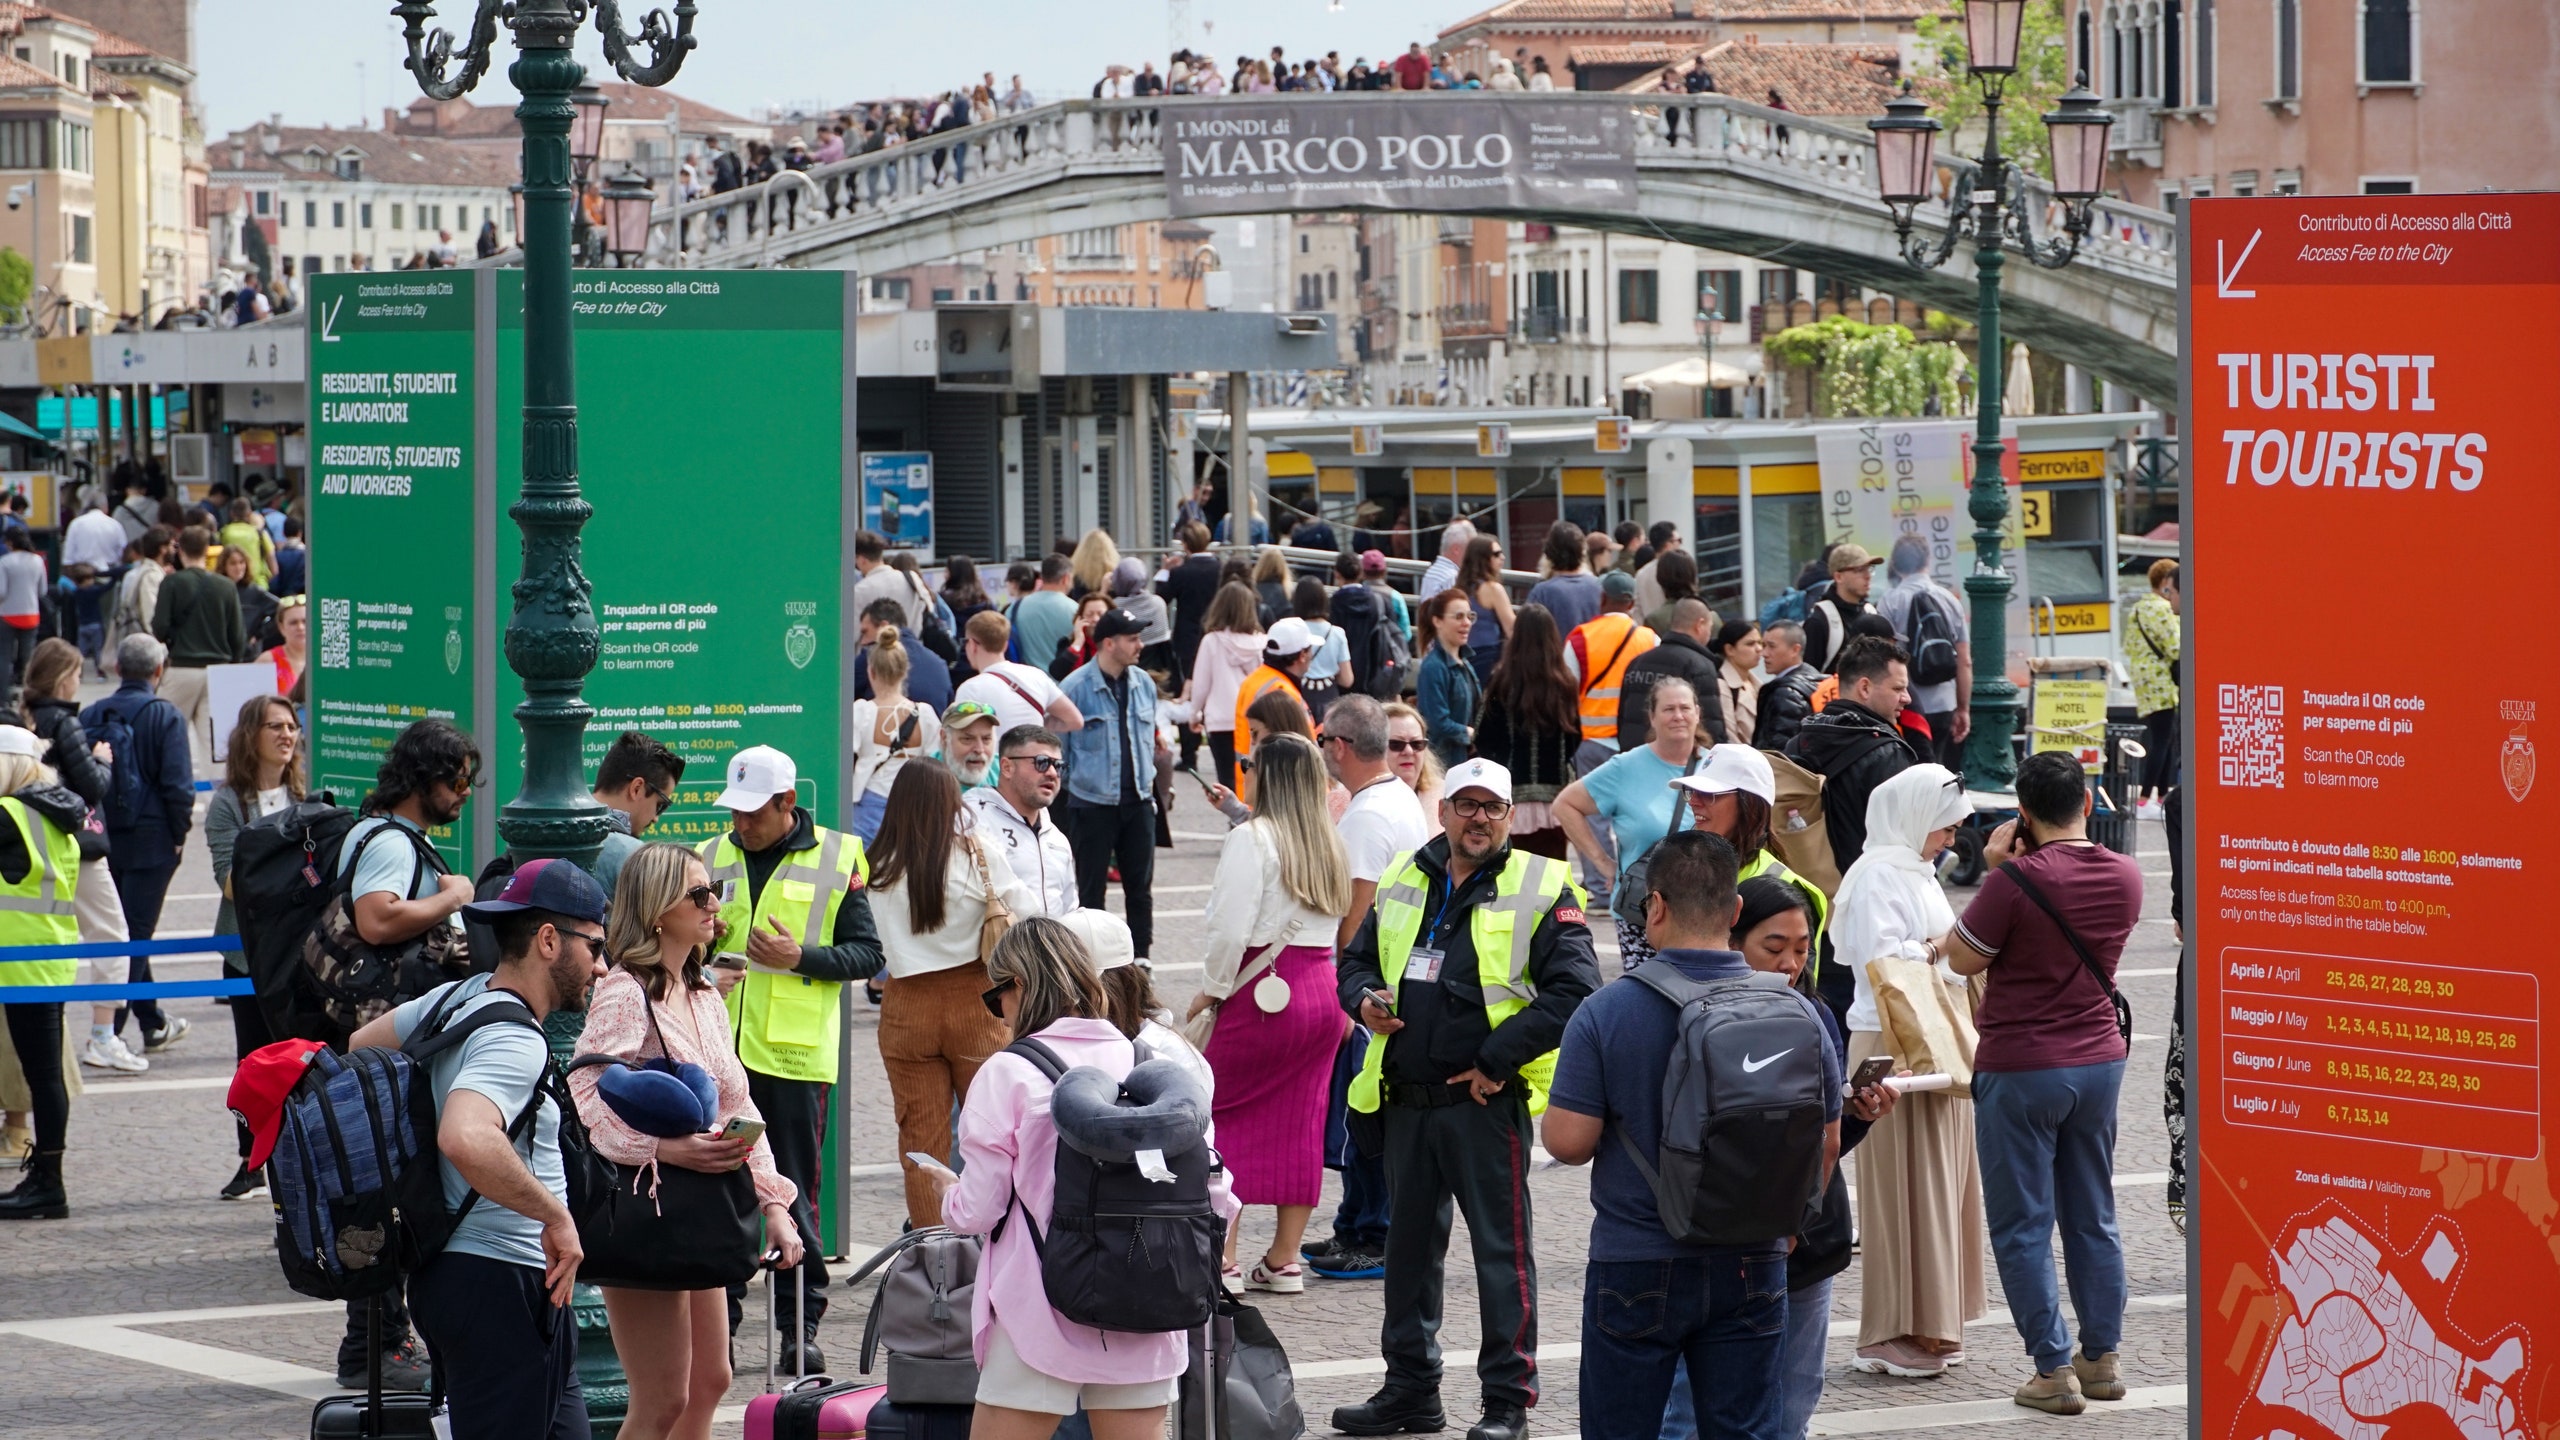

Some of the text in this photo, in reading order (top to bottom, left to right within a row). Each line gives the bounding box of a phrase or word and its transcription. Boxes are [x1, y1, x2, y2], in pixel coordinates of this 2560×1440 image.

[1176, 118, 1289, 137] I MONDI di
[1177, 133, 1512, 178] MARCO POLO
[1196, 182, 1247, 198] viaggio
[1249, 180, 1265, 194] di
[1266, 184, 1286, 193] un
[1424, 175, 1447, 189] del
[2300, 212, 2511, 231] Contributo di Accesso alla Città
[2298, 243, 2453, 264] Access Fee to the City
[359, 282, 453, 297] Contributo di Accesso alla Città
[594, 281, 606, 293] di
[609, 282, 663, 294] Accesso
[666, 282, 687, 294] alla
[690, 282, 719, 294] Città
[358, 303, 428, 318] Access Fee to the City
[572, 302, 596, 313] Fee
[598, 303, 613, 314] to
[615, 302, 637, 314] the
[639, 302, 667, 316] City
[247, 344, 278, 367] A B
[322, 373, 456, 397] RESIDENTI, STUDENTI
[2218, 354, 2434, 410] TURISTI
[322, 402, 408, 422] E LAVORATORI
[322, 445, 460, 470] RESIDENTS, STUDENTS
[1859, 425, 1885, 493] 2024
[2019, 457, 2090, 476] Ferrovia
[2223, 429, 2487, 491] TOURISTS
[322, 474, 411, 496] AND WORKERS
[1894, 432, 1922, 533] eigners
[1830, 489, 1854, 544] Arte
[389, 603, 397, 614] QR
[398, 604, 413, 615] code
[604, 603, 717, 617] Inquadra il QR code
[357, 619, 367, 630] per
[391, 619, 397, 630] di
[603, 619, 706, 633] per saperne di più
[2055, 703, 2086, 714] HOTEL
[2304, 690, 2424, 710] Inquadra il QR code
[2526, 701, 2536, 711] DI
[2500, 710, 2536, 721] VENEZIA
[2304, 716, 2412, 736] per saperne di più
[2304, 747, 2404, 767] Scan the QR code
[2304, 770, 2378, 788] to learn more
[1002, 828, 1018, 848] 3
[2220, 835, 2522, 869] Il contributo è dovuto dalle 8:30 alle 16:00, solamente
[2221, 856, 2454, 885] nei giorni indicati nella tabella sottostante.
[2230, 963, 2300, 983] Aprile April
[2327, 971, 2454, 997] 25, 26, 27, 28, 29, 30
[2231, 1007, 2308, 1030] Maggio May
[2233, 1051, 2310, 1072] Giugno June
[2234, 1095, 2300, 1118] Luglio July
[2328, 1105, 2389, 1126] 6, 7, 13, 14
[2296, 1170, 2430, 1198] Zona di validità Validity zone
